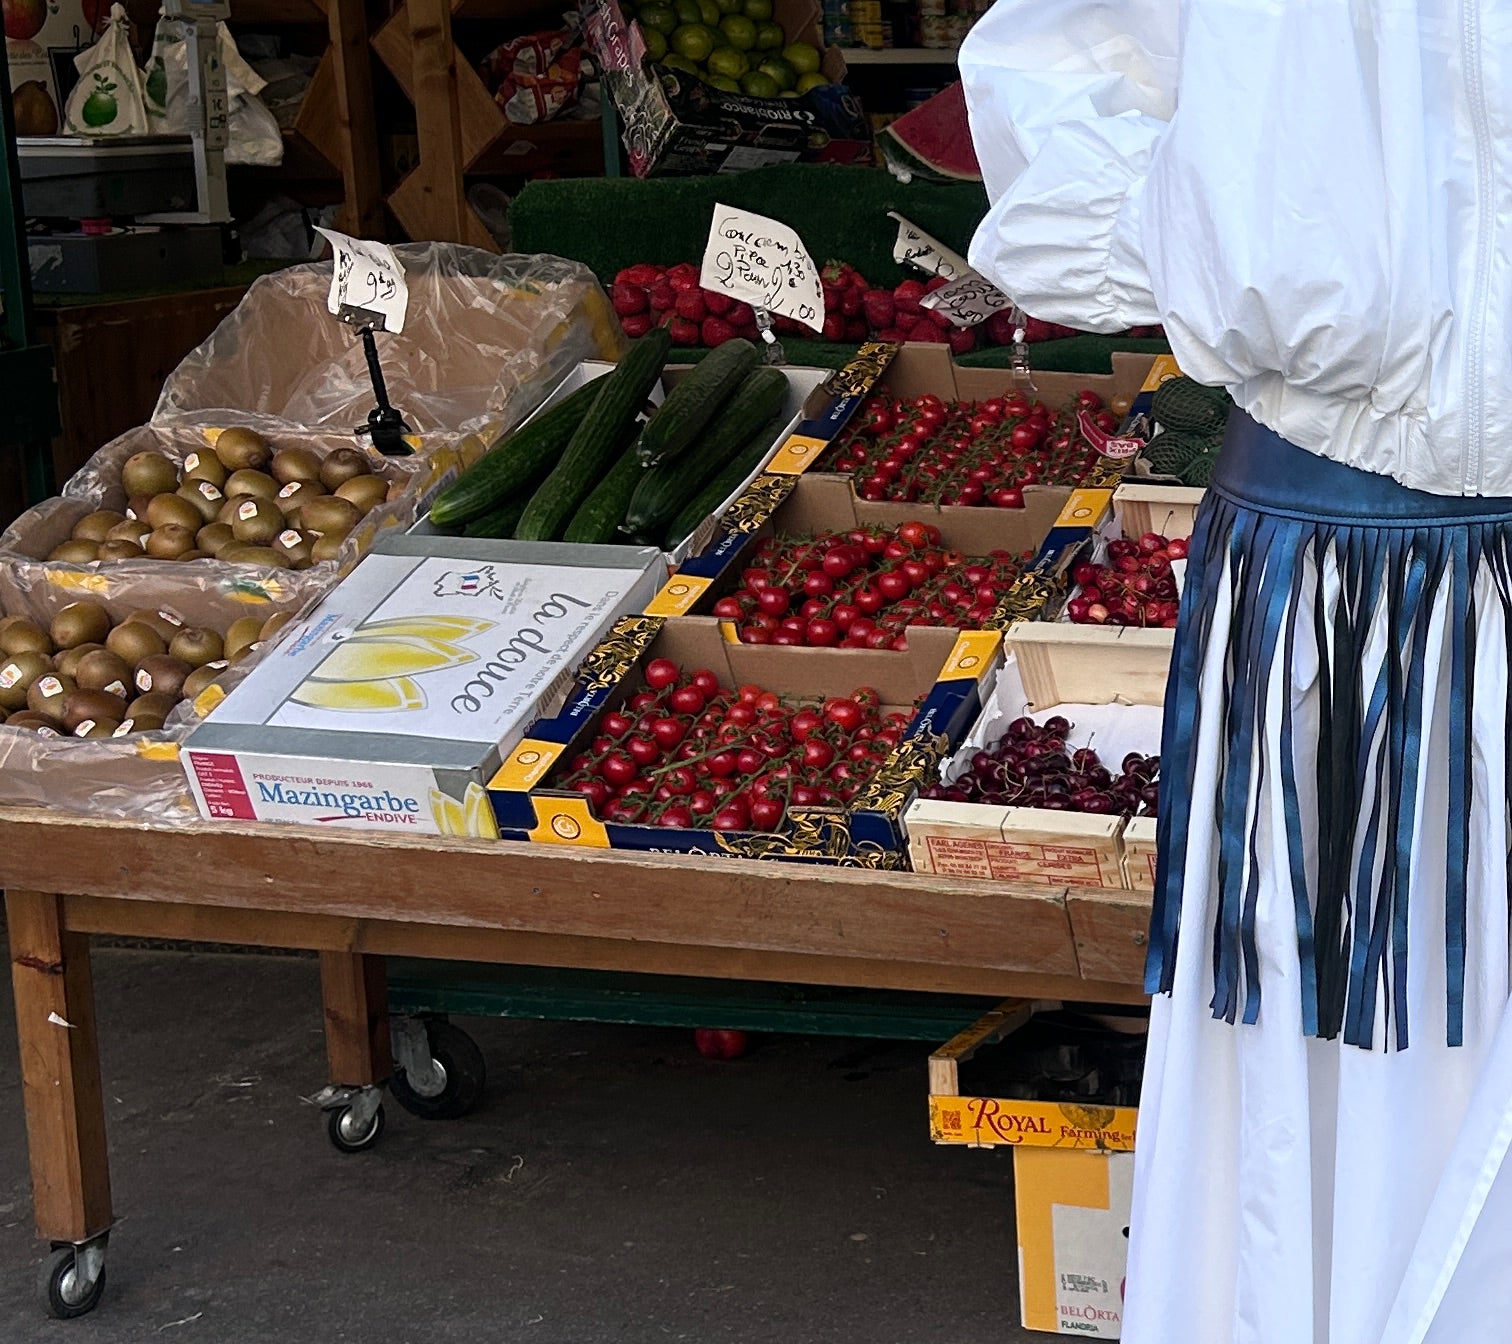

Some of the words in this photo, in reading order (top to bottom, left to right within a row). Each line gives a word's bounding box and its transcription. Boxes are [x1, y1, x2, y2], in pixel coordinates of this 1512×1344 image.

[533, 593, 593, 626] la
[556, 621, 589, 653] respect
[451, 627, 553, 715] douce
[546, 653, 562, 666] de
[525, 665, 550, 690] notre
[255, 781, 420, 817] Mazingarbe
[365, 812, 418, 825] ENDIVE
[967, 1098, 1052, 1143] ROYAL
[1061, 1126, 1121, 1142] Farming
